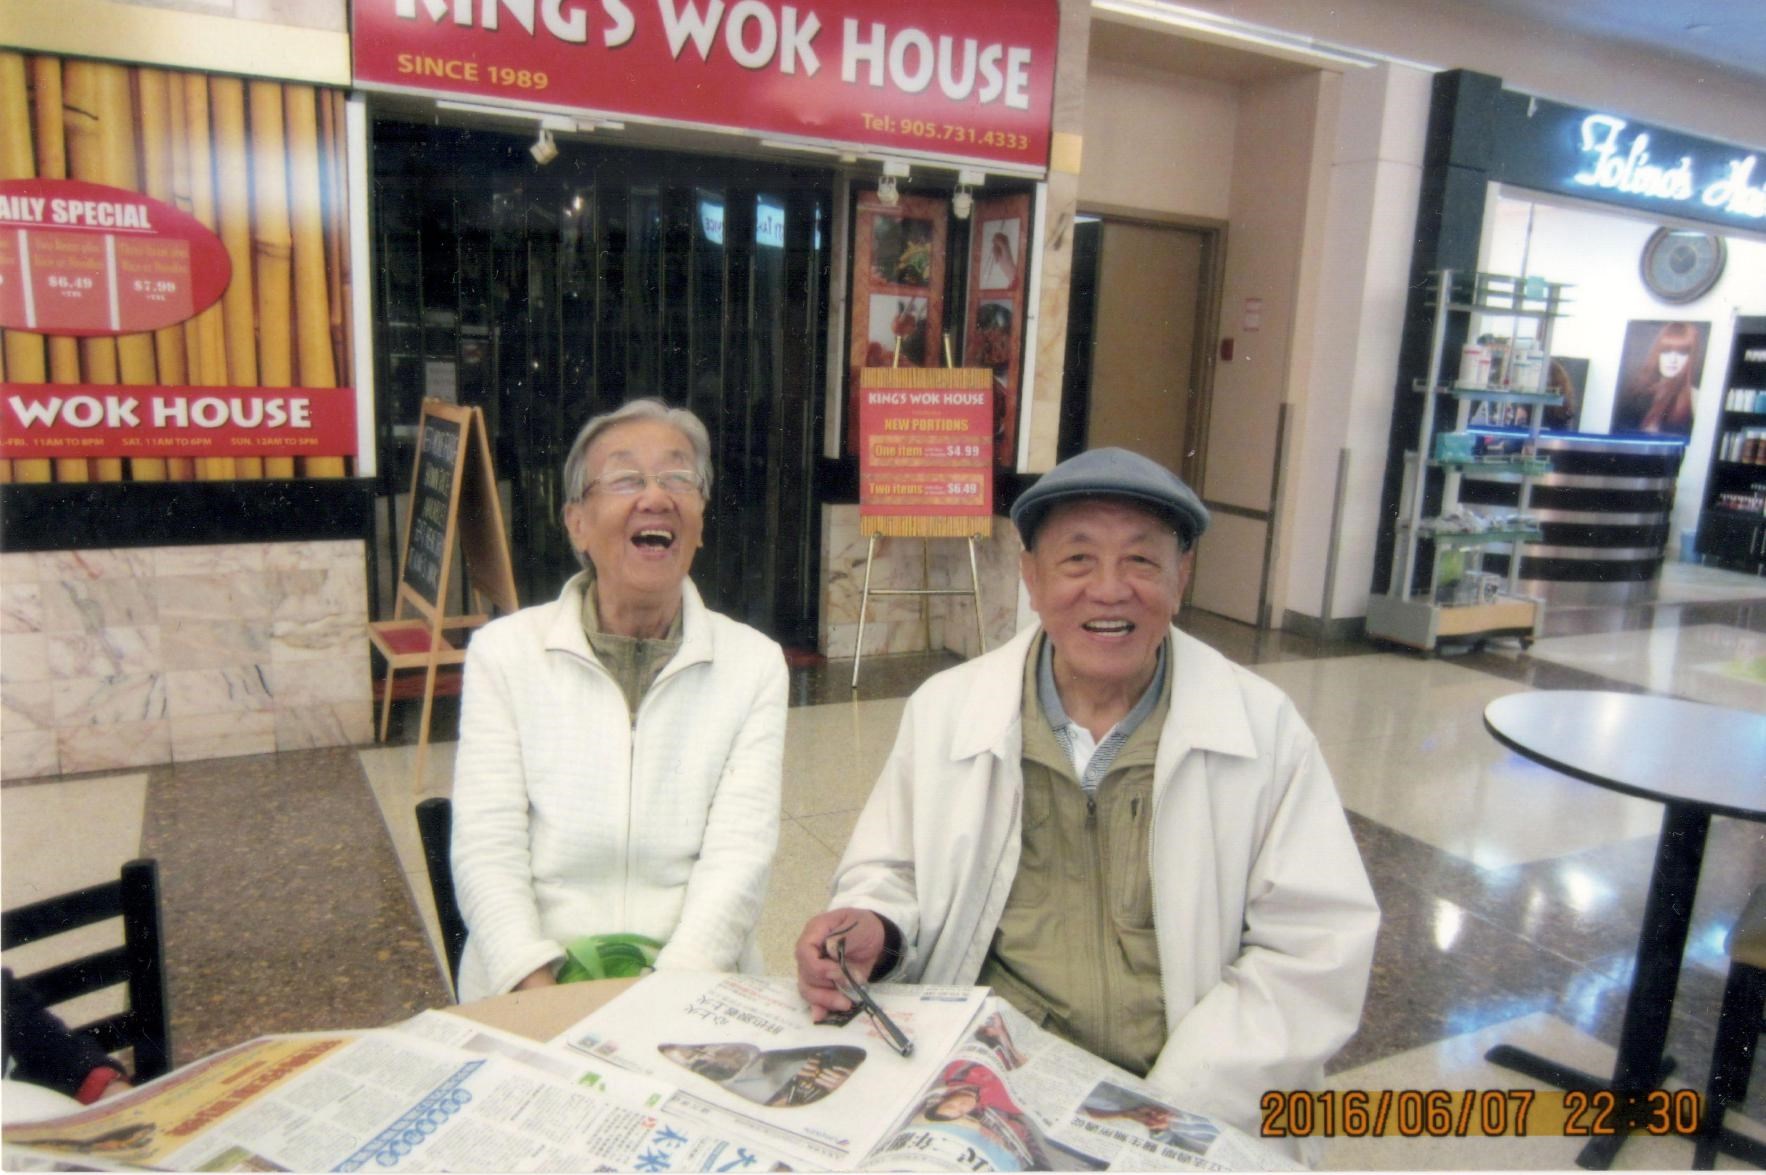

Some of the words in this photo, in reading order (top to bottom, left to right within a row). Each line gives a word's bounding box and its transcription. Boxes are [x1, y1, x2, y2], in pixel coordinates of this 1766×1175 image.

[656, 0, 822, 77] WOK
[841, 17, 1032, 110] HOUSE
[397, 53, 479, 81] SINCE
[487, 66, 548, 90] 1989
[861, 112, 896, 132] Tel:
[900, 118, 1029, 150] 905.731.4333
[51, 198, 152, 229] SPECIAL
[8, 395, 141, 429] WOK
[152, 396, 312, 428] HOUSE
[910, 392, 940, 405] WOK
[943, 393, 985, 405] HOUSE
[884, 419, 910, 432] NEW
[912, 419, 969, 432] PORTIONS
[65, 438, 79, 446] TO
[175, 438, 189, 446] TO
[284, 437, 297, 446] TO
[946, 444, 980, 457] $4.99
